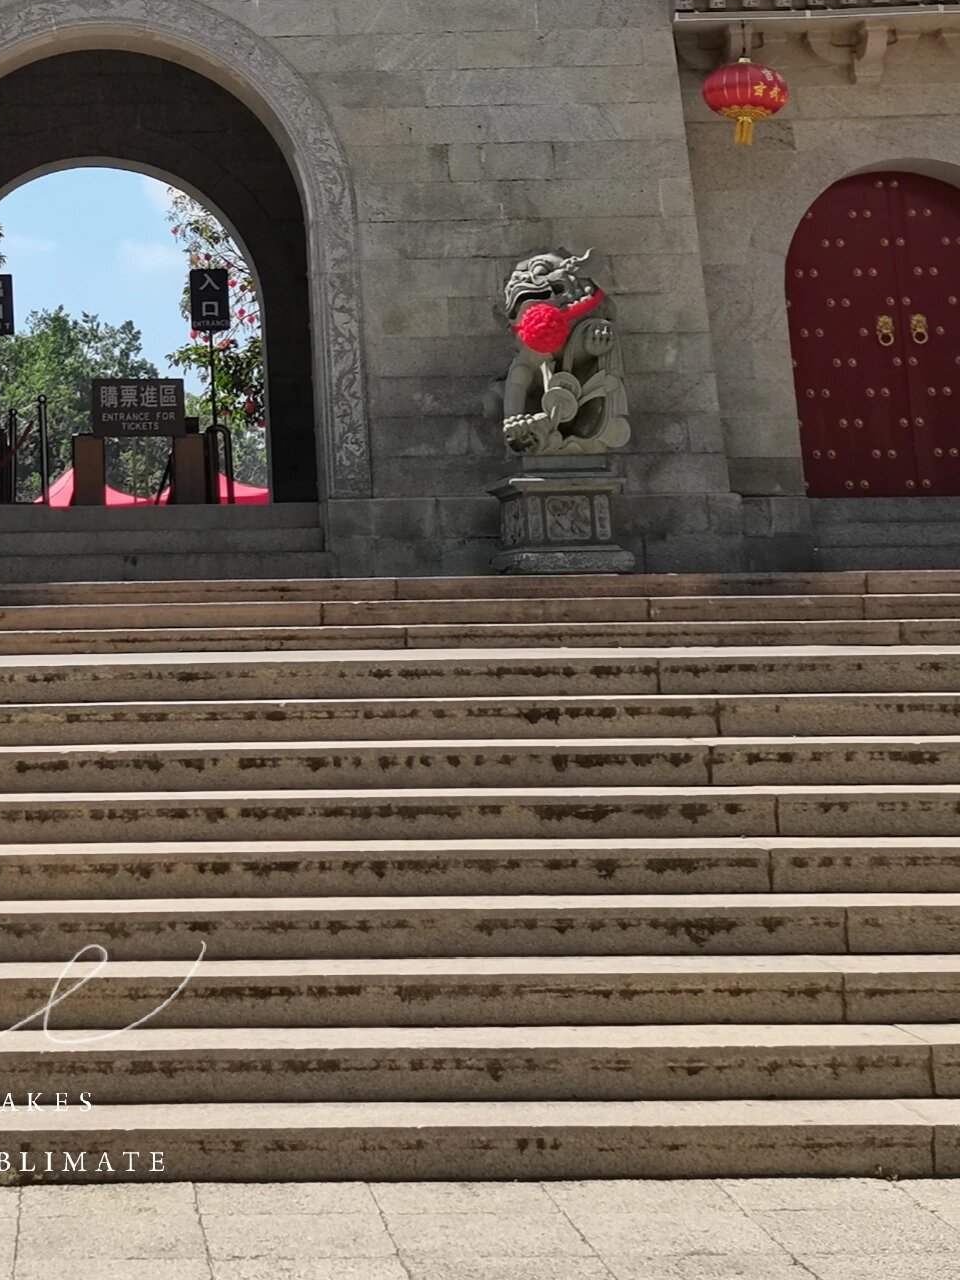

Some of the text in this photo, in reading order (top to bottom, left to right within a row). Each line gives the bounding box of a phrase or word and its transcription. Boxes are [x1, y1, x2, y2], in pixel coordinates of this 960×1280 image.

[198, 273, 220, 317] 入口
[100, 384, 177, 408] 購票進區
[102, 411, 176, 422] ENTRANCE FOR
[121, 421, 160, 431] TICKETS
